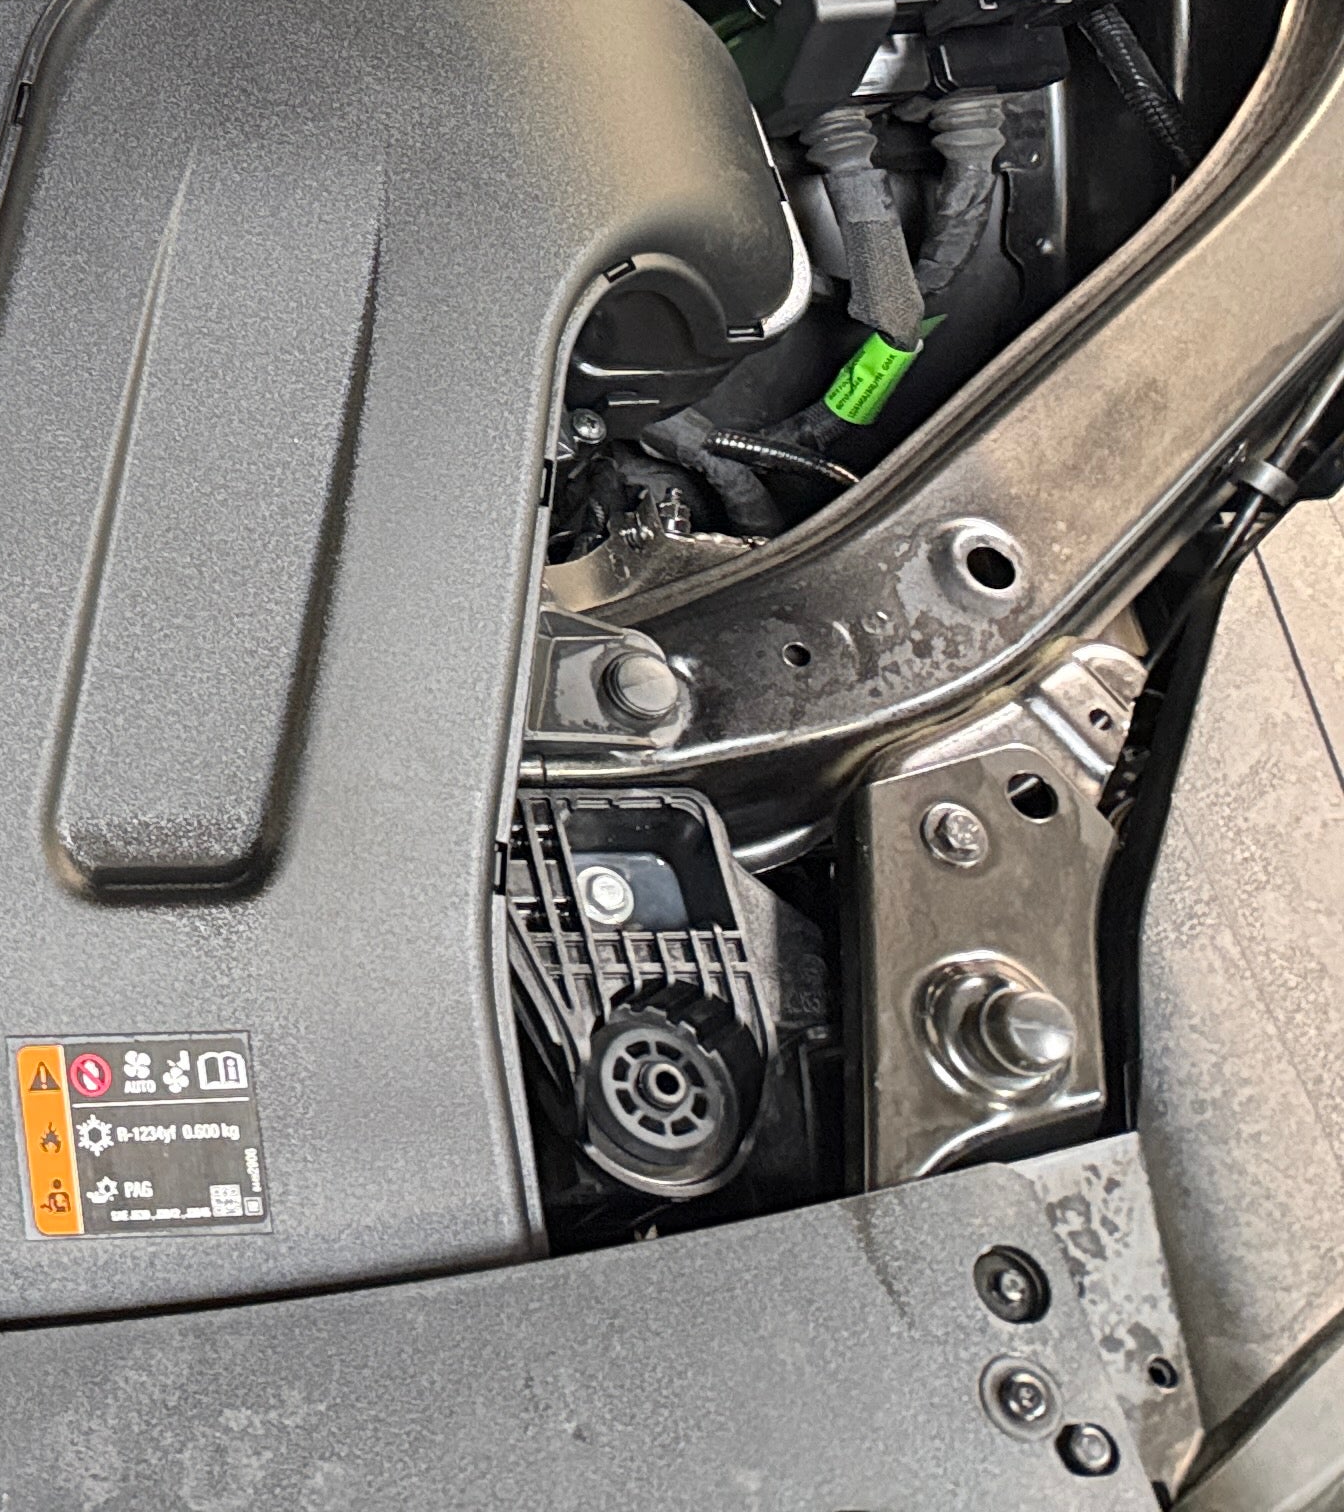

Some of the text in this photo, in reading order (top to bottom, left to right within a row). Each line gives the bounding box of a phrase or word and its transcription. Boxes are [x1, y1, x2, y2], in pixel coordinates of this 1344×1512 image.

[123, 1079, 157, 1094] AUTO
[116, 1125, 177, 1144] R-1234yf
[221, 1123, 241, 1141] kg
[123, 1180, 154, 1199] PAG
